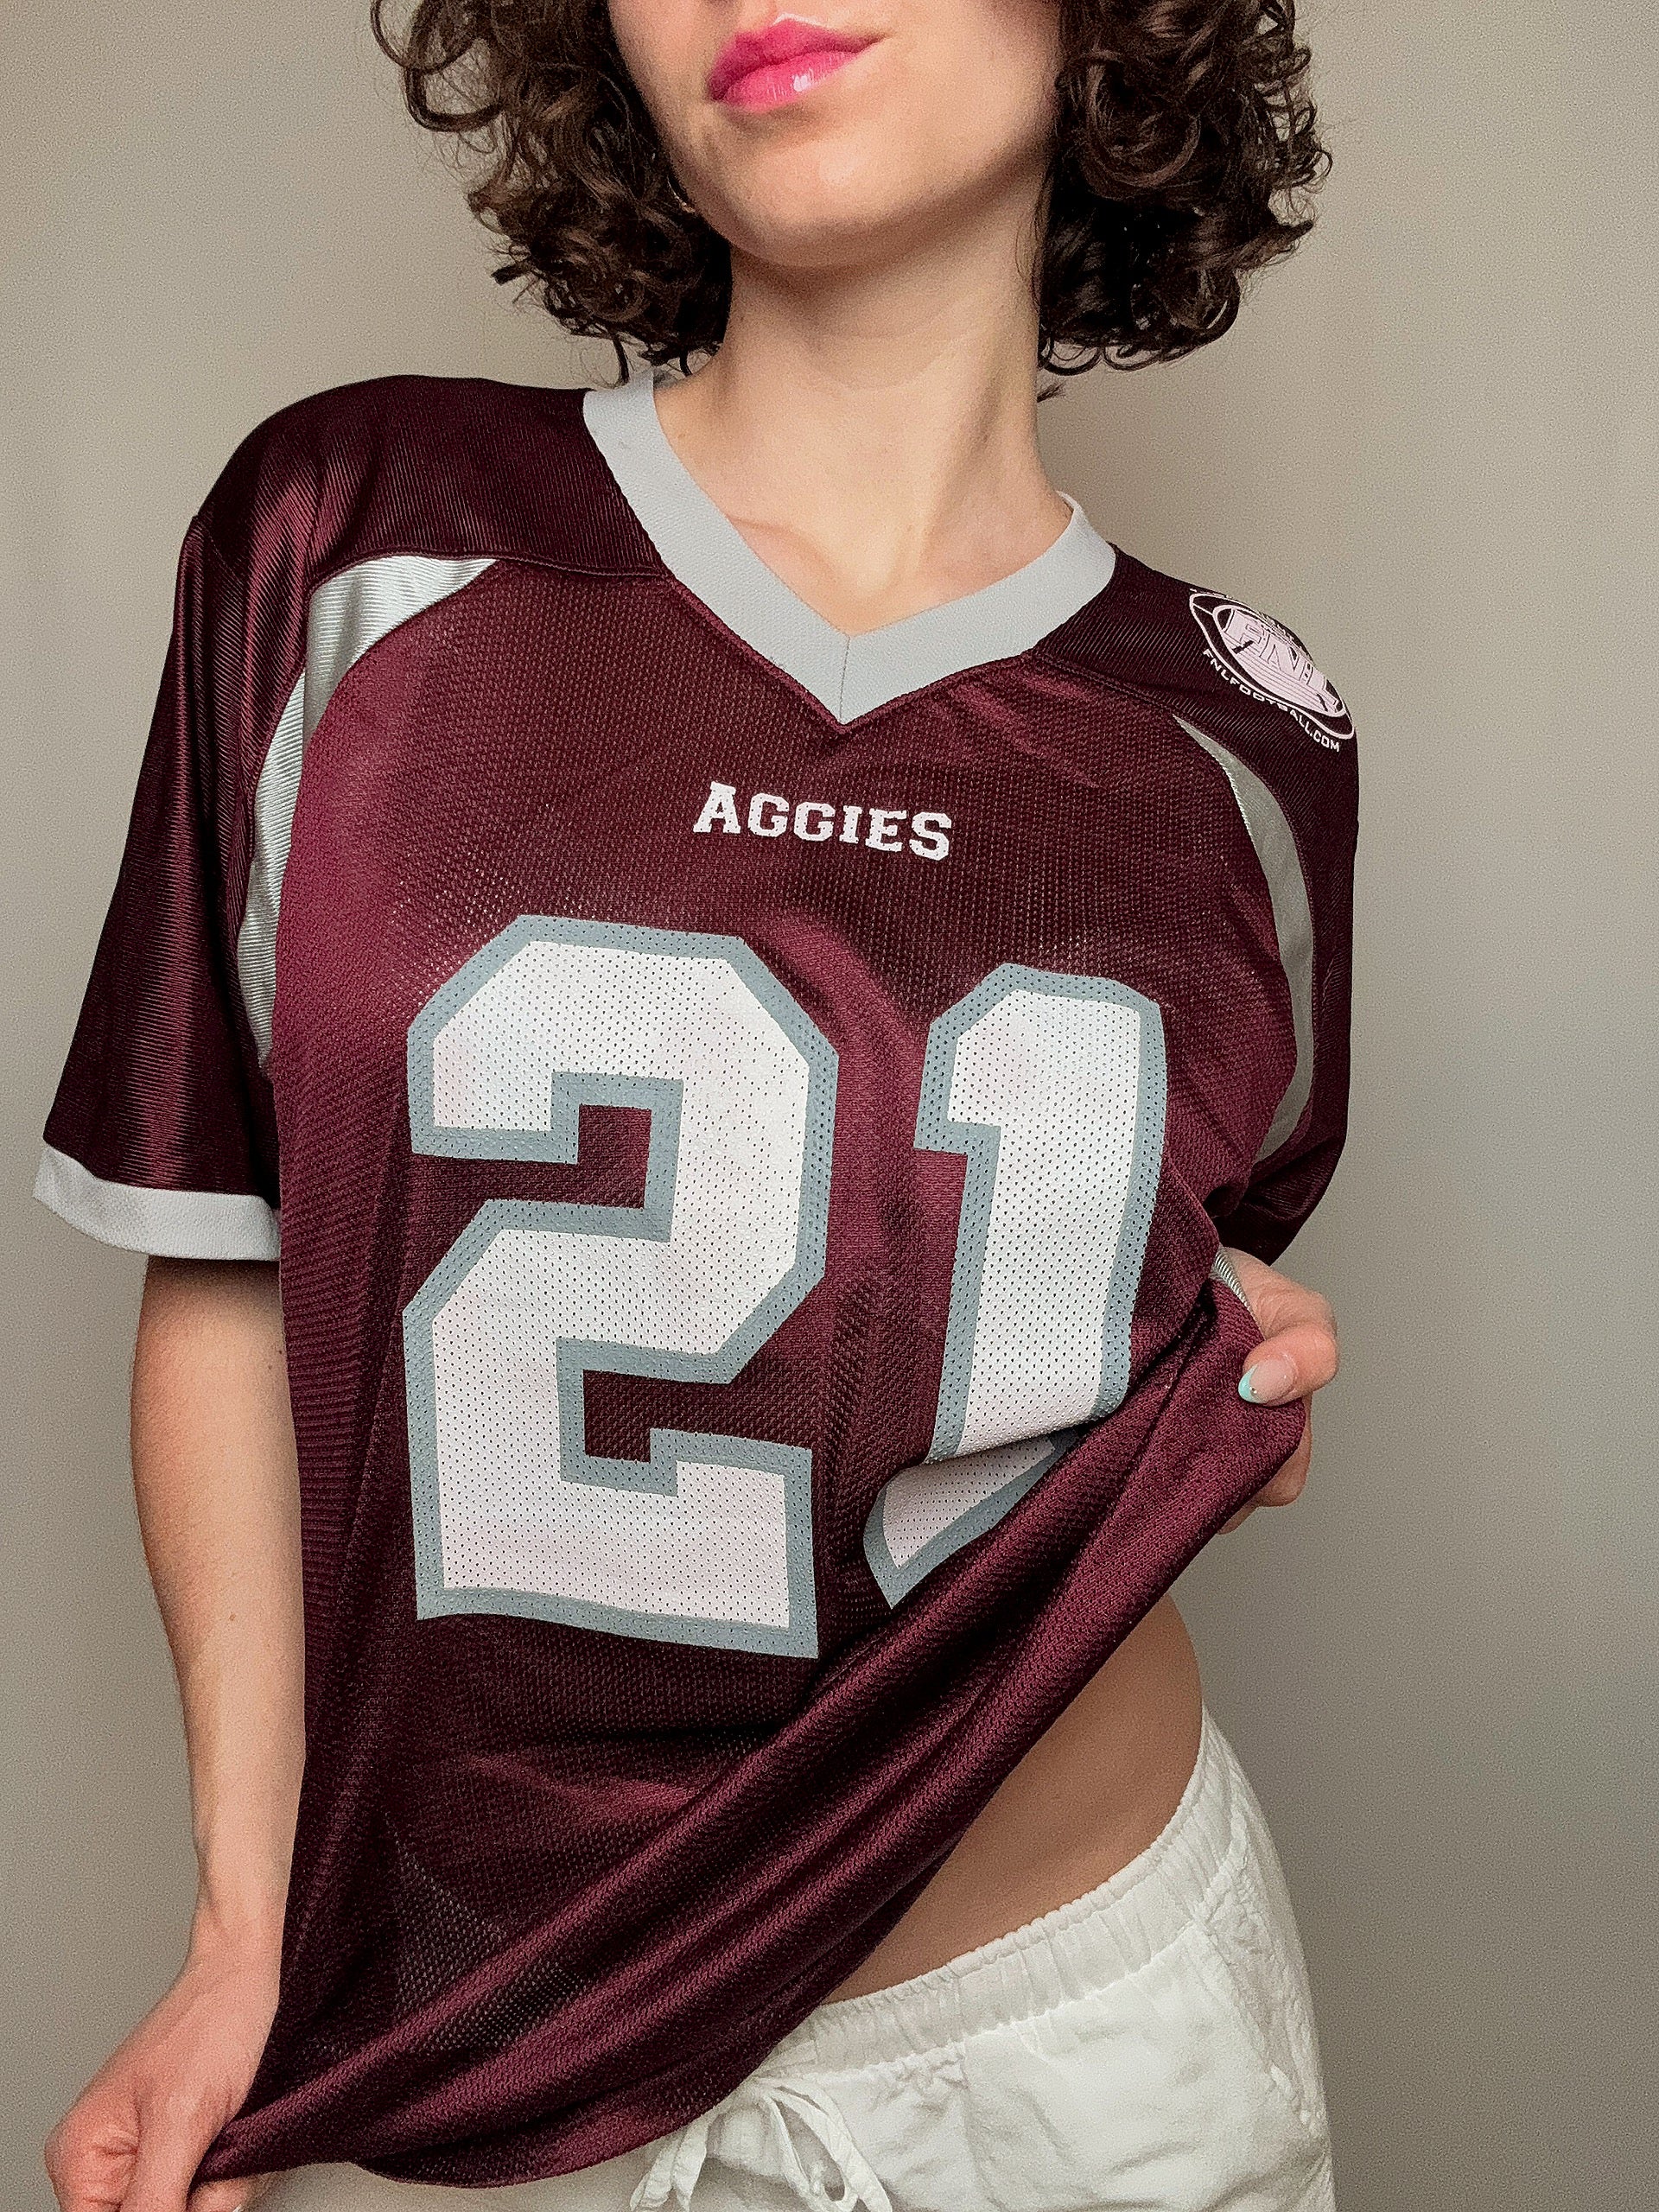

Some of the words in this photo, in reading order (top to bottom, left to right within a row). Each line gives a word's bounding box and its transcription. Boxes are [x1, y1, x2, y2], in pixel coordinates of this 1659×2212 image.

[1203, 649, 1339, 752] FNLFOOTBALL.COM
[692, 780, 952, 861] AGGIES
[402, 913, 1168, 1659] 21
